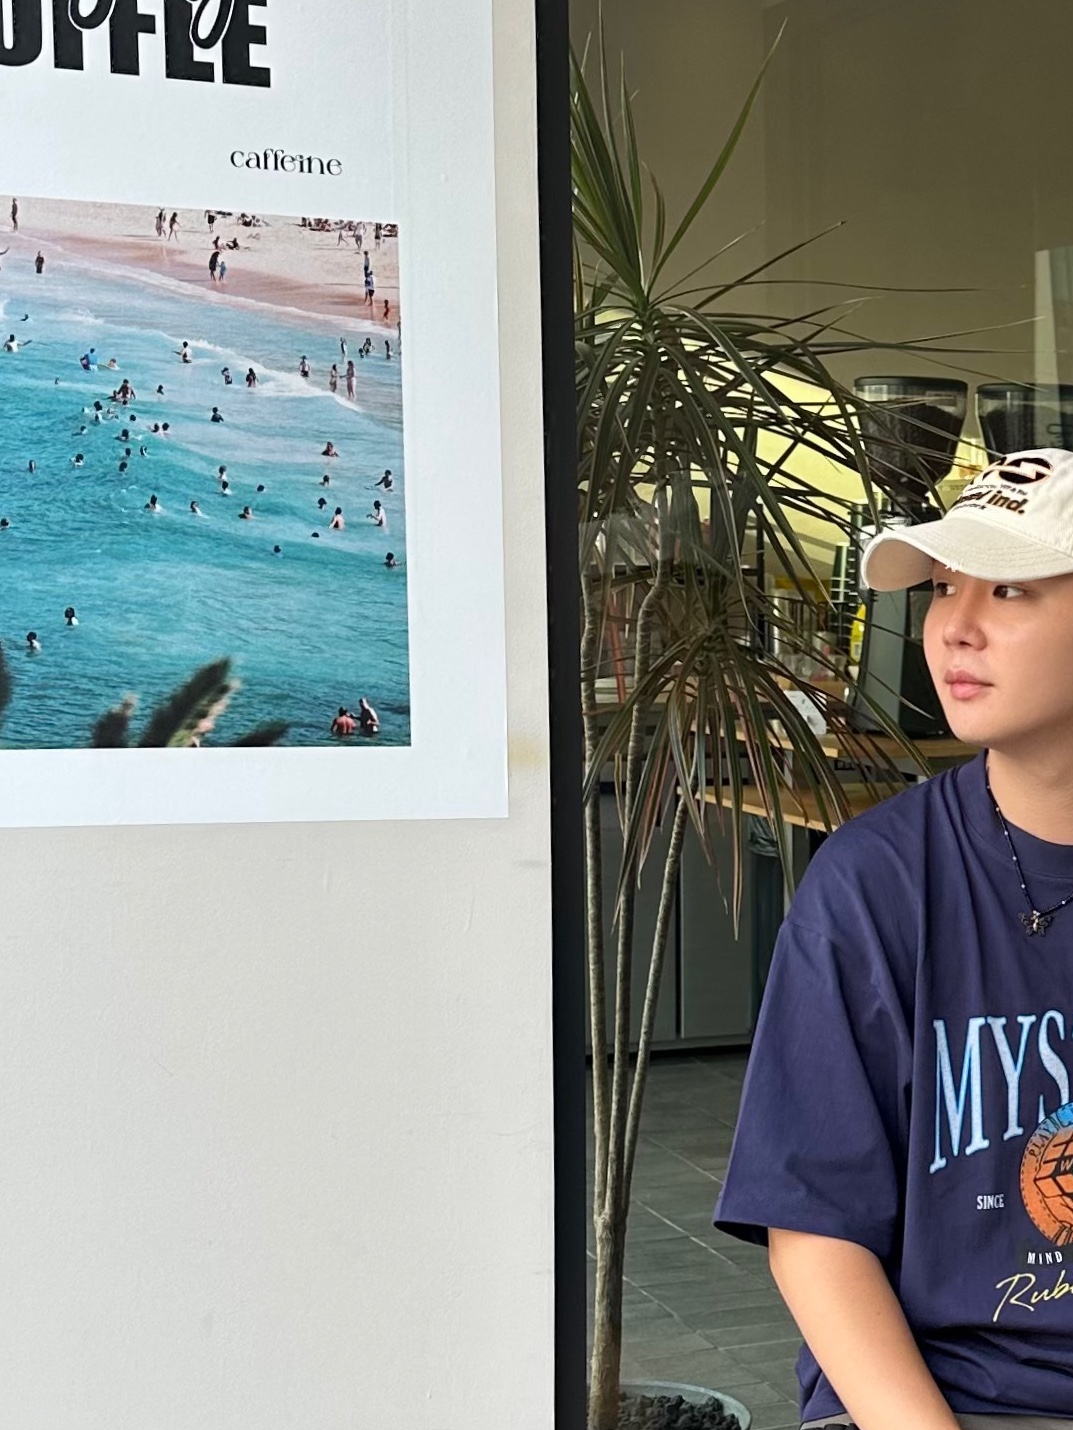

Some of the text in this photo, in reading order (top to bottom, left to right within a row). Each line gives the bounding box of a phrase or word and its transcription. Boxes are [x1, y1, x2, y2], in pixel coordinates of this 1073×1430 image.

[230, 148, 343, 176] caffeine
[976, 1193, 1005, 1210] SINCE
[1026, 1250, 1064, 1265] MIND
